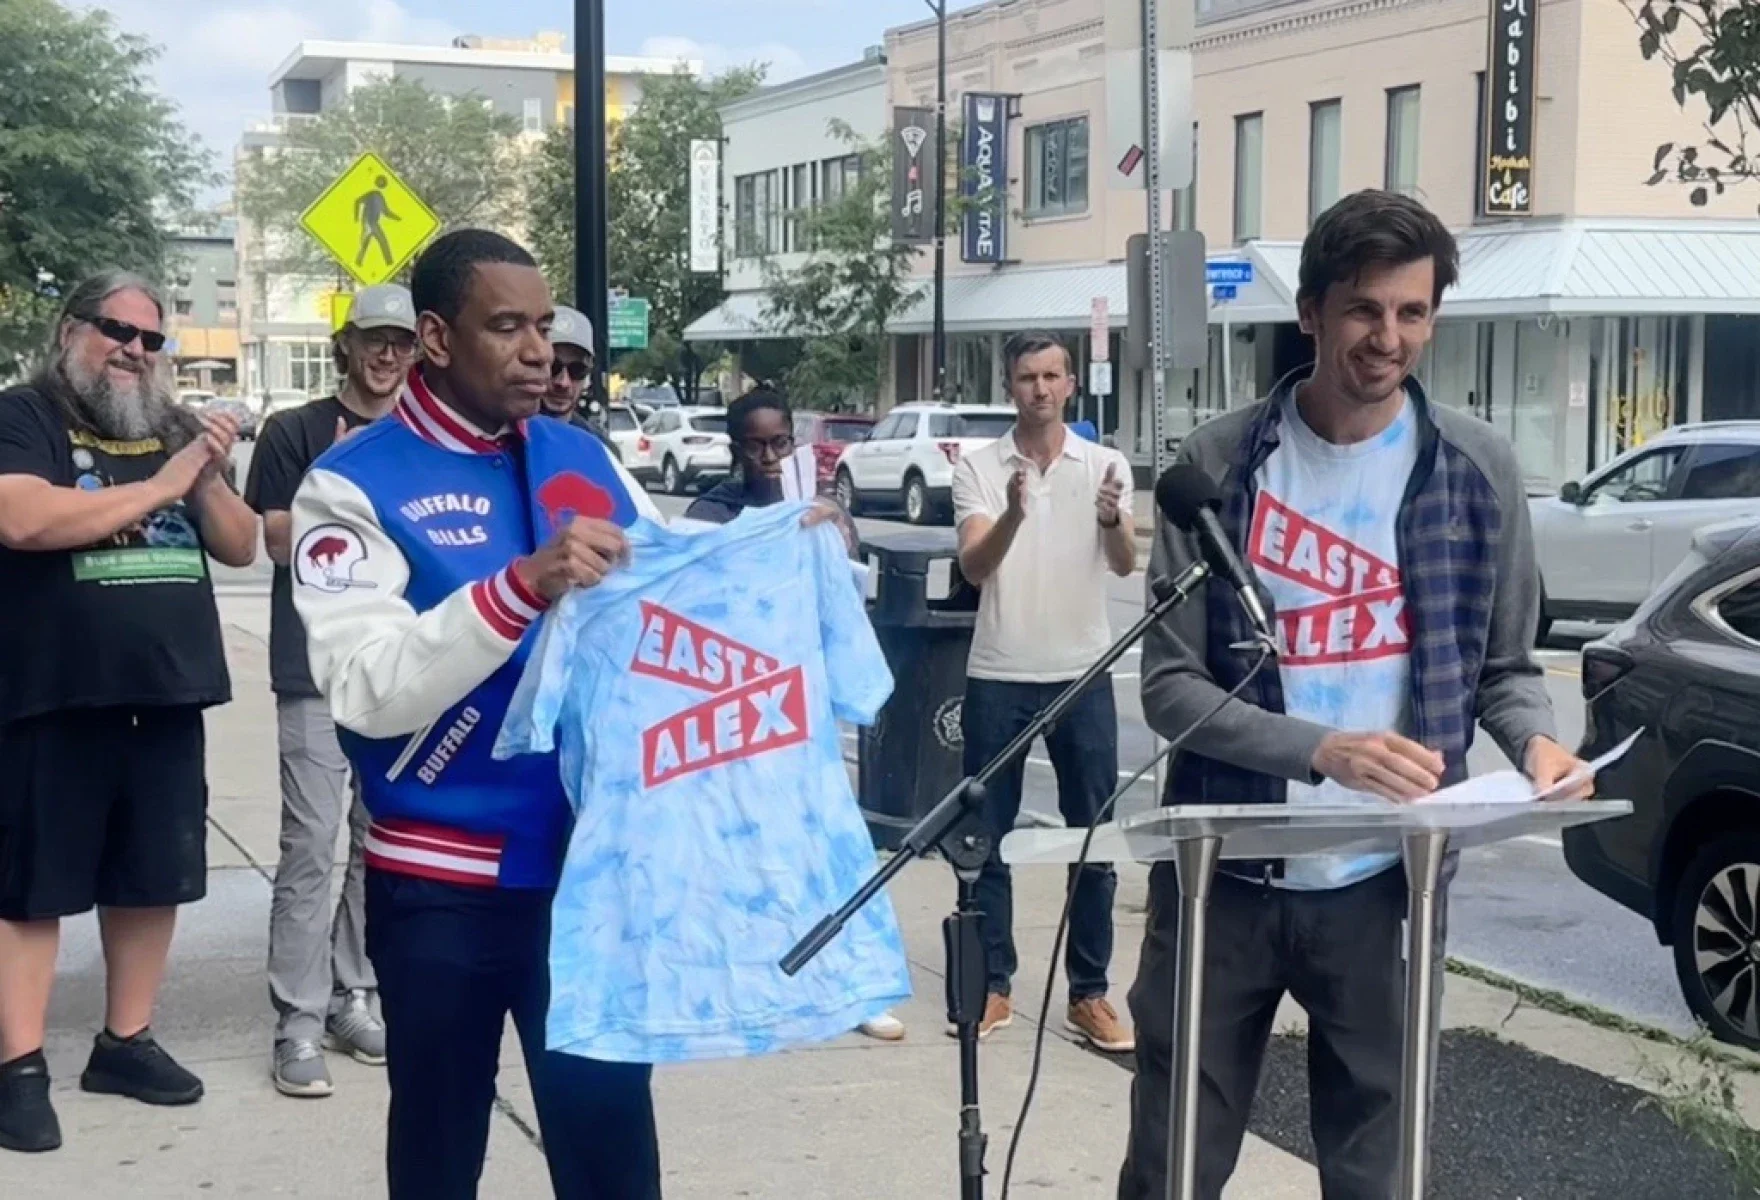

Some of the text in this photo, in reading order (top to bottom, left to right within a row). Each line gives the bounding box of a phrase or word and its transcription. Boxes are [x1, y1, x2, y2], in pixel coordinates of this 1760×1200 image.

[975, 125, 994, 190] AQUA
[1490, 181, 1529, 208] Cafe
[399, 493, 491, 522] BUFFALO
[426, 525, 488, 545] BILLS
[1259, 506, 1394, 596] EAST &
[637, 613, 771, 688] EAST &
[417, 705, 482, 785] BUFFALO
[652, 678, 799, 778] ALEX
